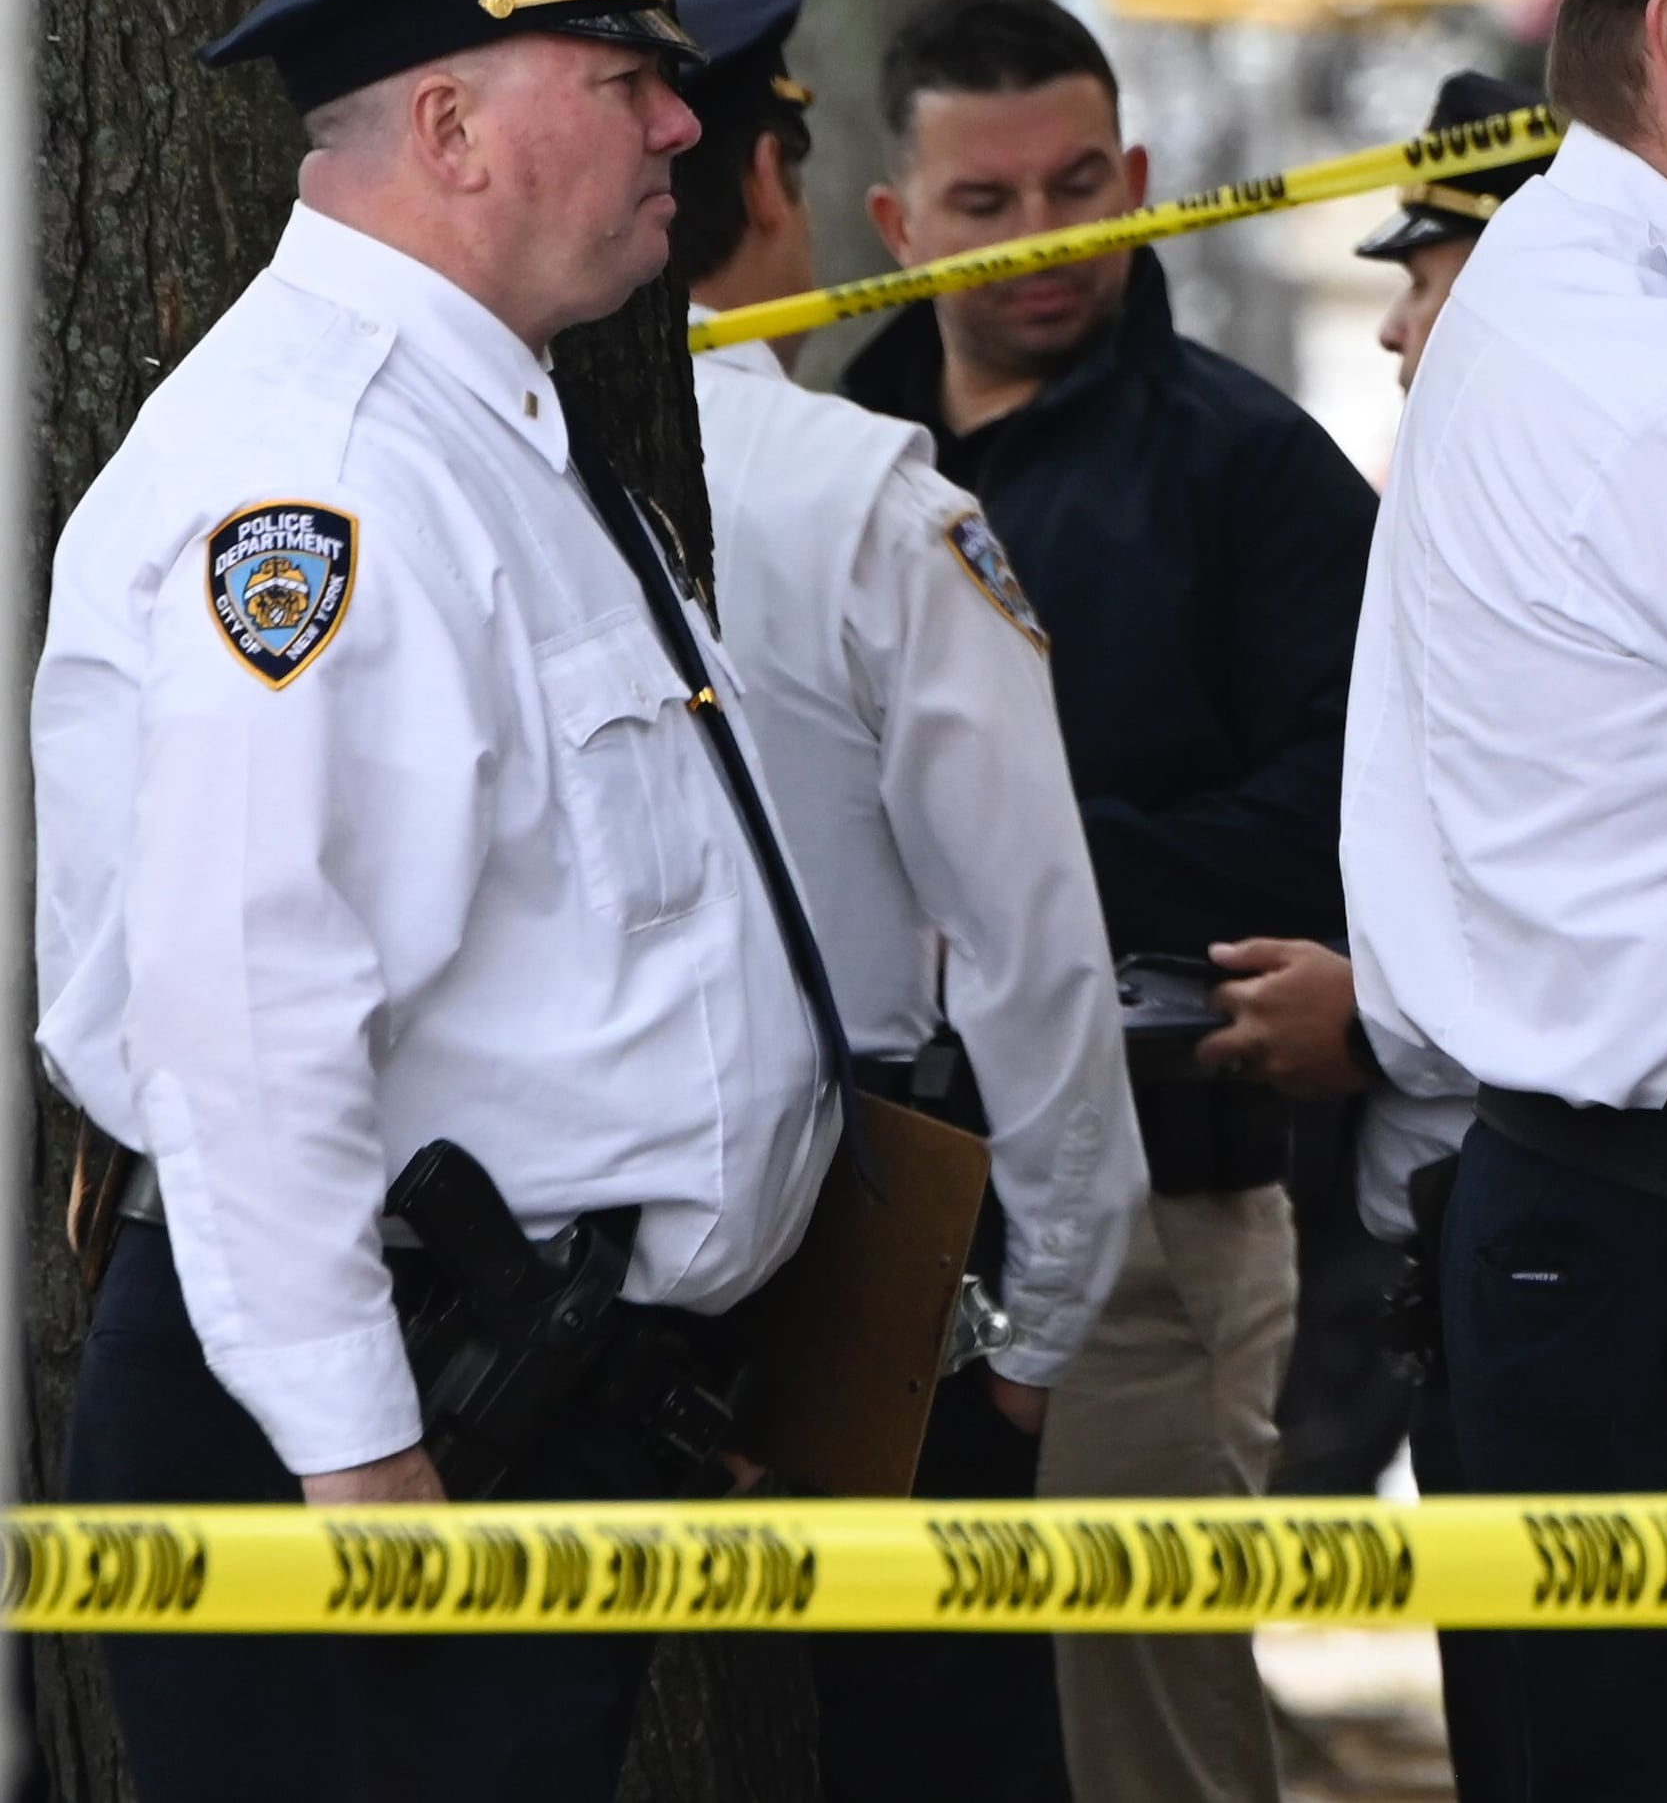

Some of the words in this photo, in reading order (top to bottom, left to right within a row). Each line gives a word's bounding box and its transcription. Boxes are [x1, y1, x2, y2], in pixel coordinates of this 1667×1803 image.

[214, 532, 344, 577] DEPARTMENT
[238, 512, 315, 542] POLICE
[215, 594, 243, 635] CITY
[238, 633, 263, 655] OF
[286, 624, 320, 661] NEW
[314, 573, 345, 622] YORK
[1525, 1512, 1650, 1609] CROSS
